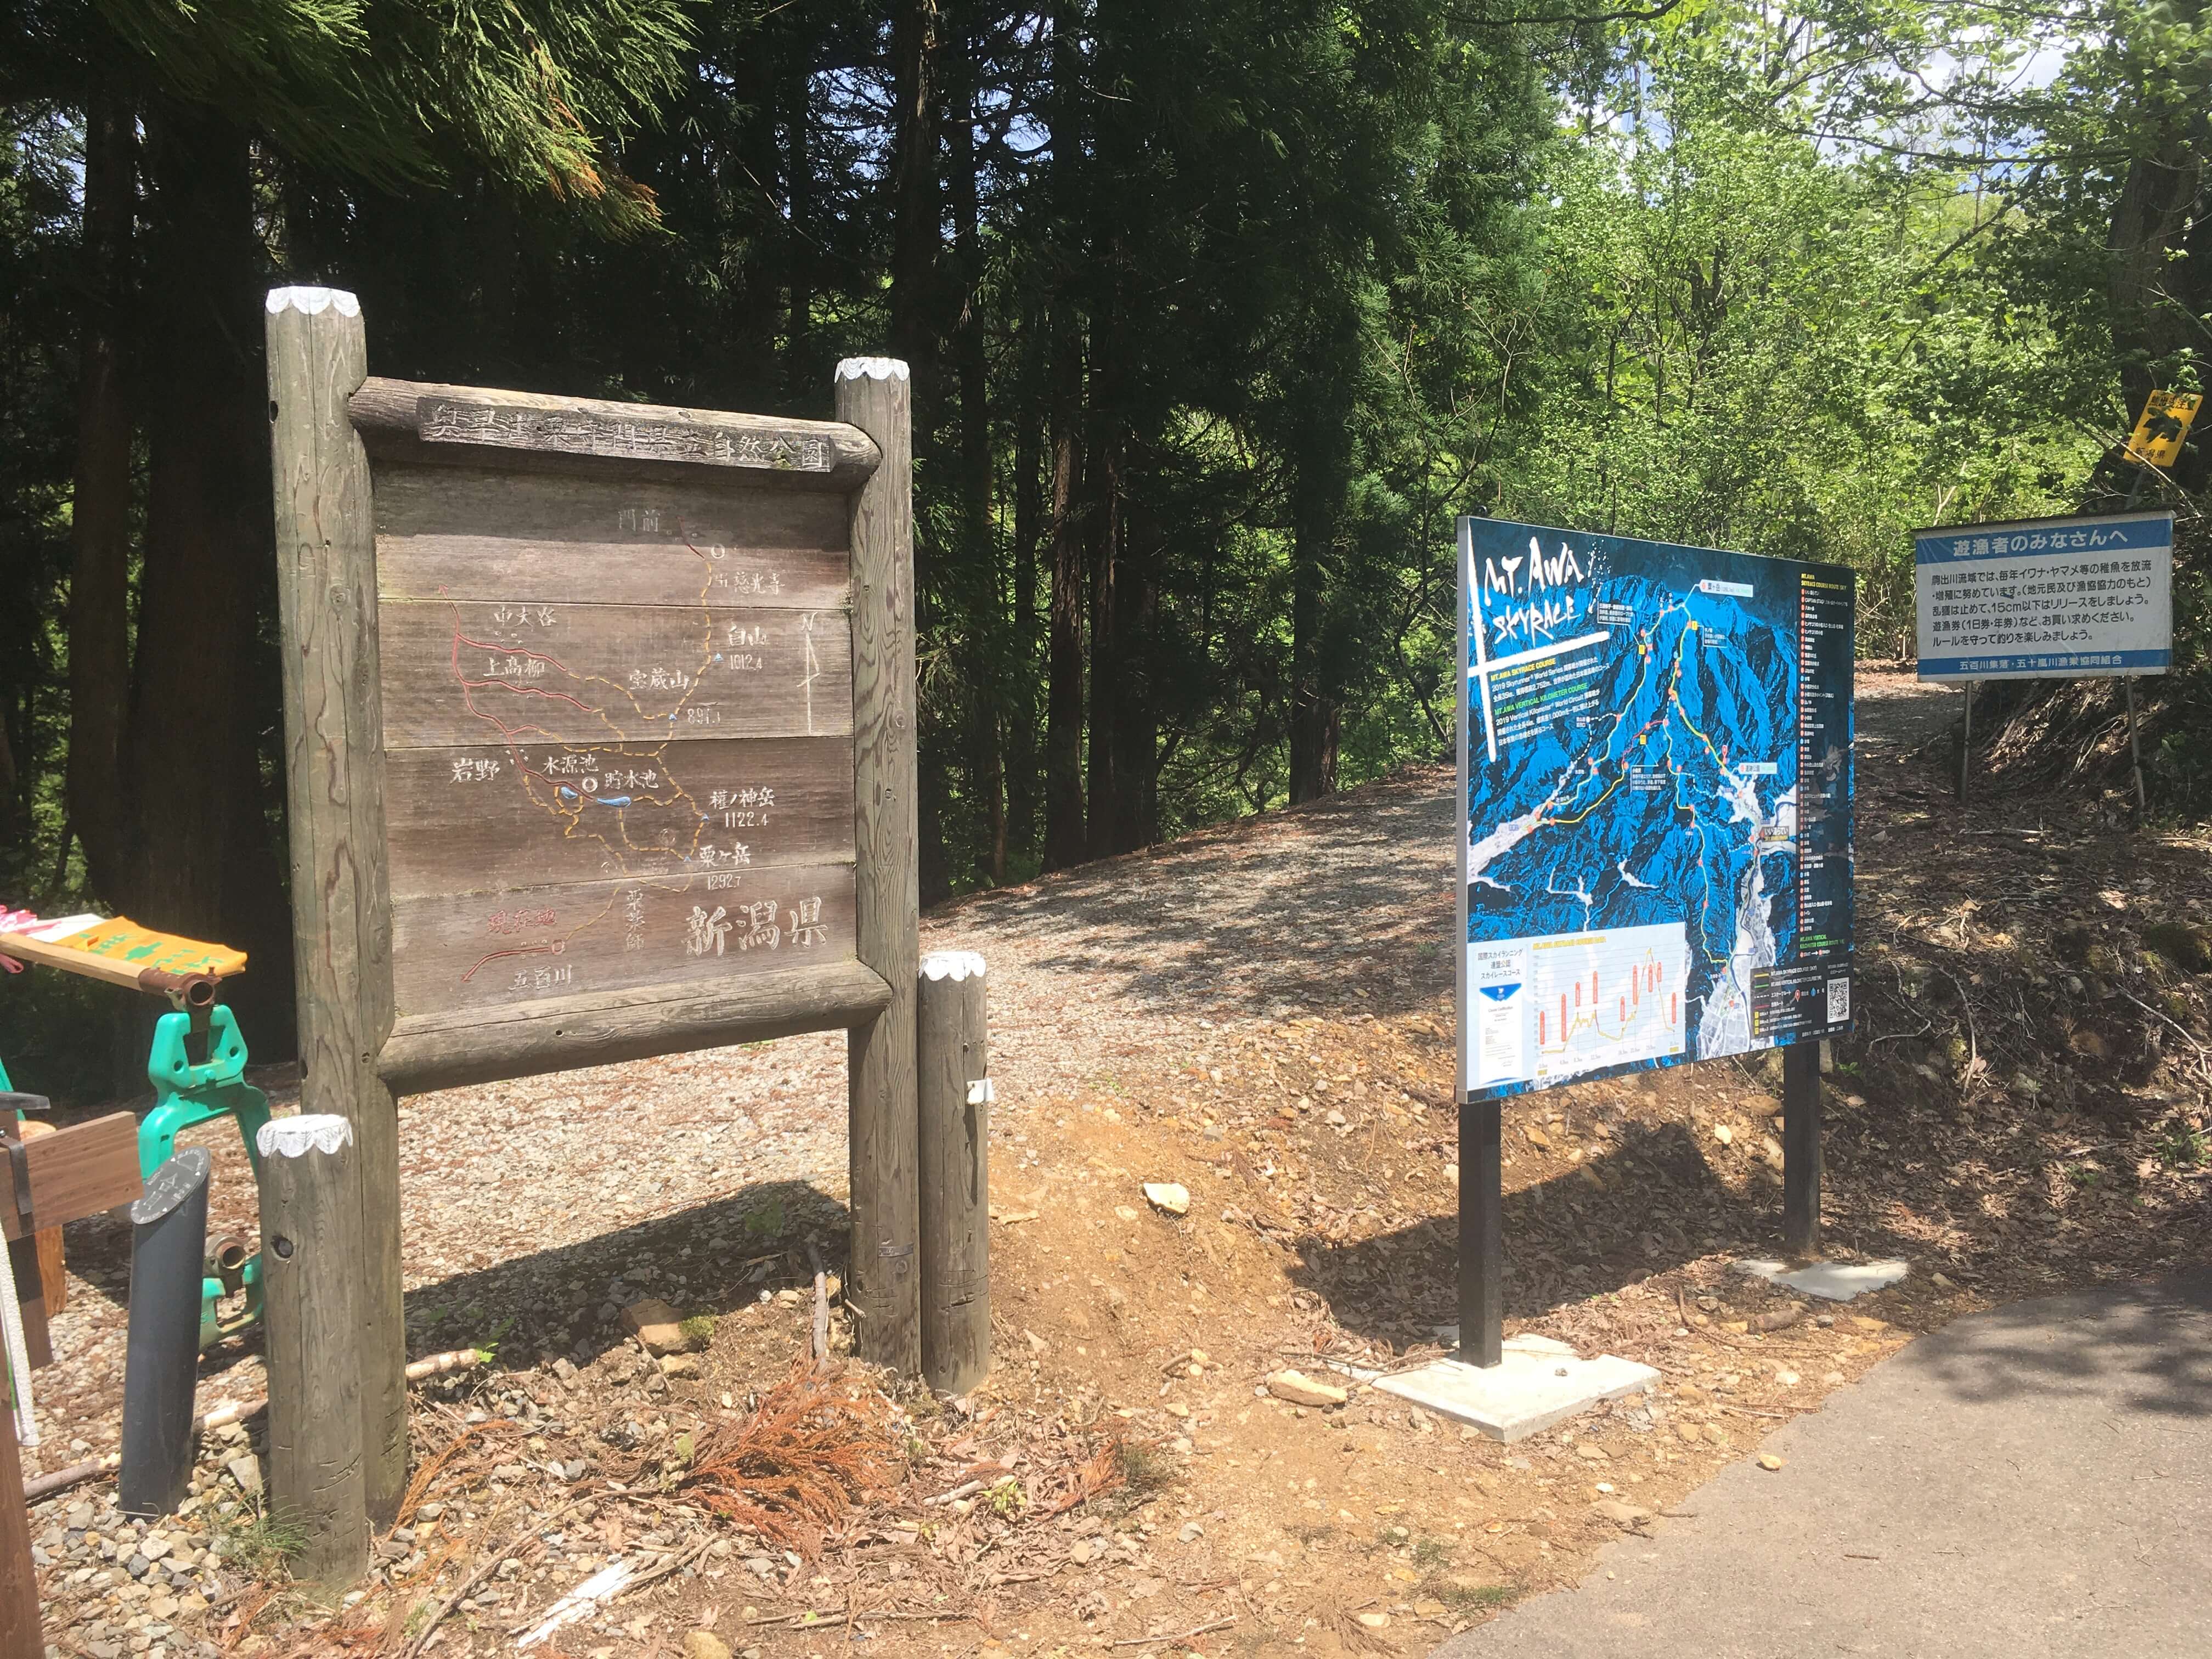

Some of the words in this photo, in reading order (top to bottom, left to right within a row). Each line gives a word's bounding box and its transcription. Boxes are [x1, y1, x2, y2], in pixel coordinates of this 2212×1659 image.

[1953, 529, 2128, 557] 遊漁者のみなさんへ
[1528, 536, 1584, 598] AWA
[733, 571, 785, 596] 慈光寺
[801, 612, 817, 632] N
[1492, 595, 1581, 648] SKYRACE
[1932, 629, 2093, 647] ルールを守って釣りを楽しみましょう。
[1492, 684, 1505, 692] 2019
[1534, 669, 1548, 679] World
[1549, 666, 1564, 675] Series
[1511, 664, 1536, 676] SKYRACE
[1536, 658, 1556, 669] COURSE
[1515, 697, 1540, 709] VERTICAL
[1539, 690, 1568, 702] KILOMETER
[1568, 682, 1588, 695] COURSE
[1496, 716, 1510, 726] 2019
[1510, 712, 1529, 722] Vertical
[1555, 698, 1569, 708] World
[450, 757, 500, 785] 岩野
[542, 754, 600, 775] 水源池
[604, 769, 659, 790] 貯水池
[698, 841, 752, 867] 粟ヶ岳
[486, 907, 558, 935] 現在地
[680, 895, 829, 957] 新潟県
[1477, 949, 1523, 961] 国際スカイランニング
[1490, 959, 1511, 969] 連盟公認
[507, 964, 573, 991] 五百川
[1481, 968, 1521, 980] スカイレースコース
